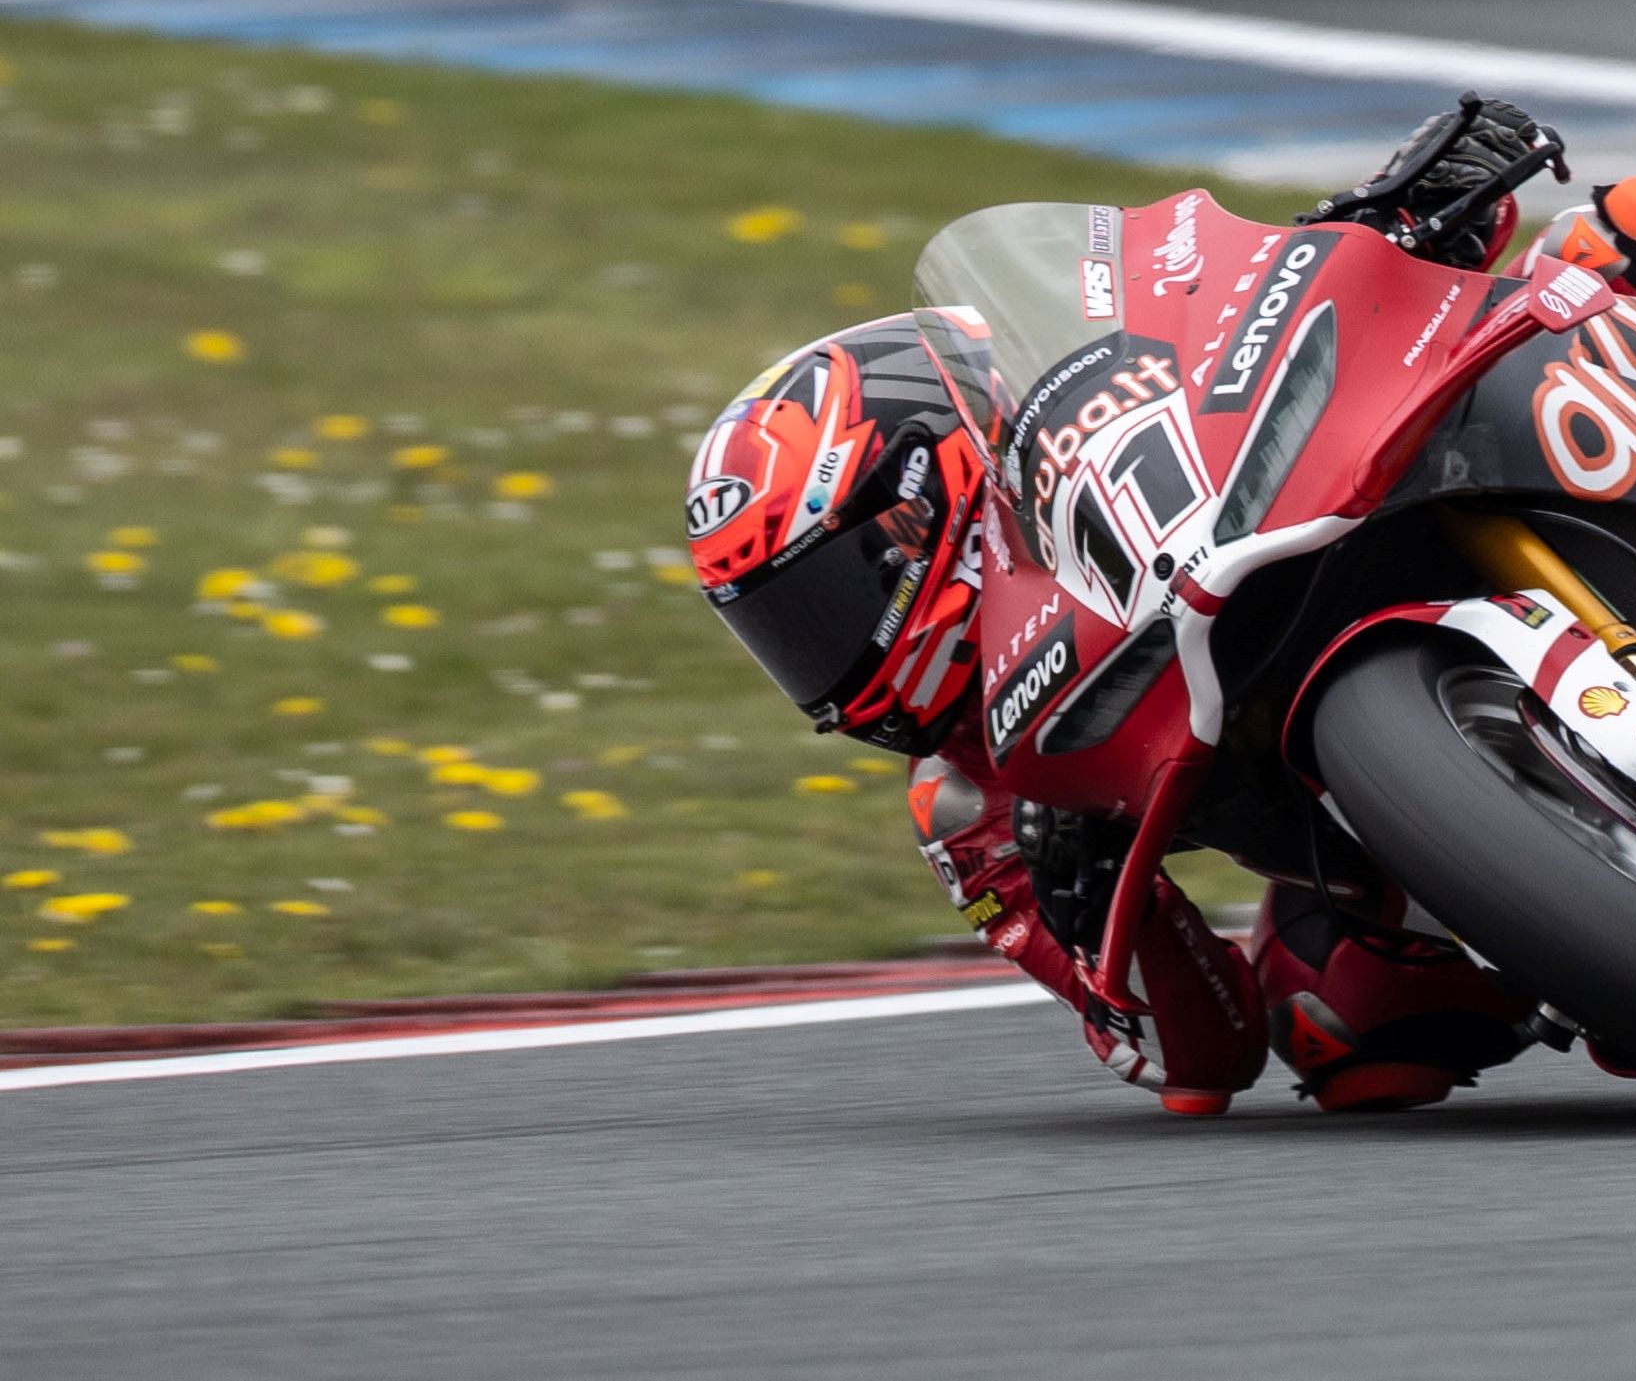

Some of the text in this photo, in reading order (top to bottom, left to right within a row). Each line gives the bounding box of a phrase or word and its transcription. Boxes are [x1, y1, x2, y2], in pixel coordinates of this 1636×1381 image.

[1191, 234, 1281, 386] ALTEN
[1212, 244, 1316, 394] Lenovo
[819, 450, 840, 484] dto
[1034, 354, 1181, 572] aruba.it
[1070, 413, 1203, 618] 11
[984, 593, 1060, 696] ALTEN
[1159, 546, 1210, 616] DUATI
[991, 640, 1067, 746] Lenovo
